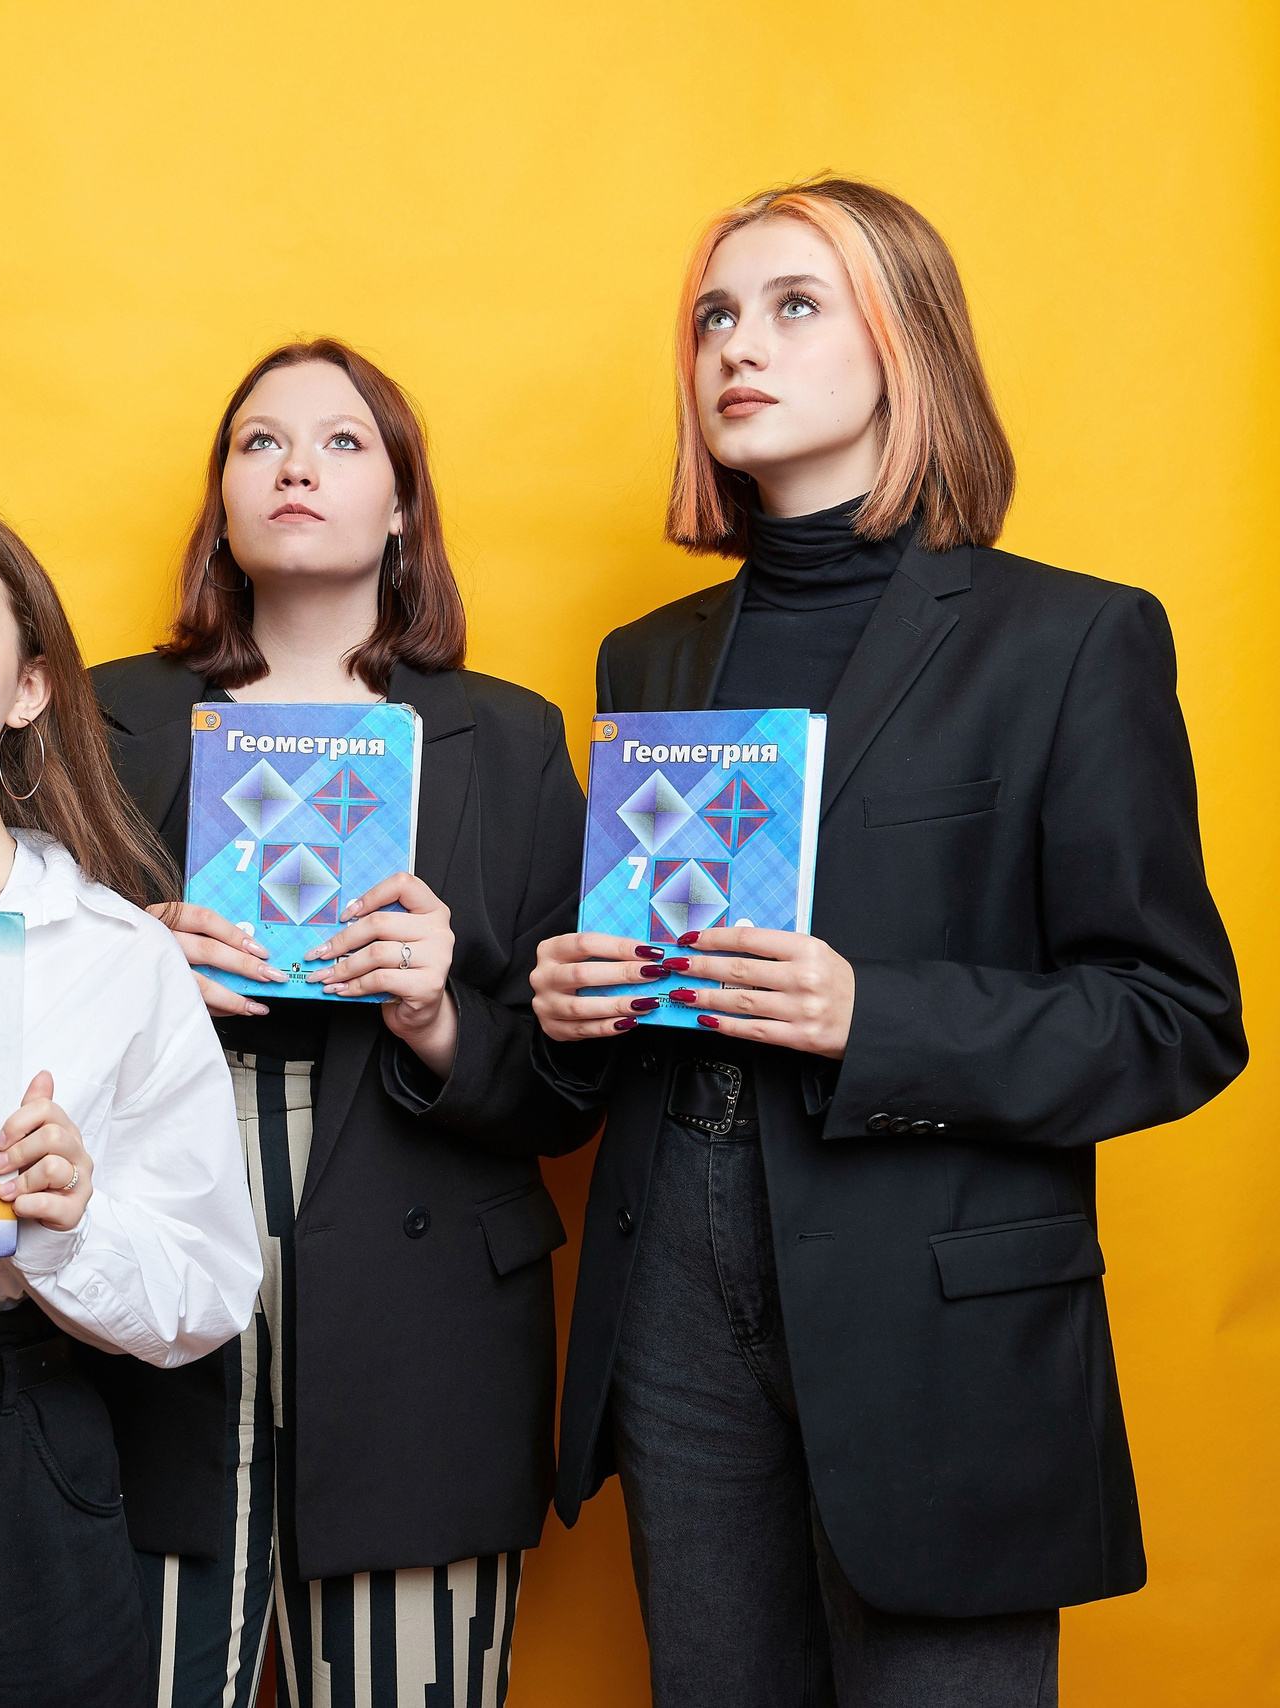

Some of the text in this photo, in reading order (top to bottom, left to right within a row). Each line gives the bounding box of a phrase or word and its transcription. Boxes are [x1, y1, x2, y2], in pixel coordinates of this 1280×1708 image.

[226, 729, 386, 760] Геометрия
[622, 740, 778, 769] Геометрия
[234, 840, 256, 872] 7
[626, 857, 648, 889] 7
